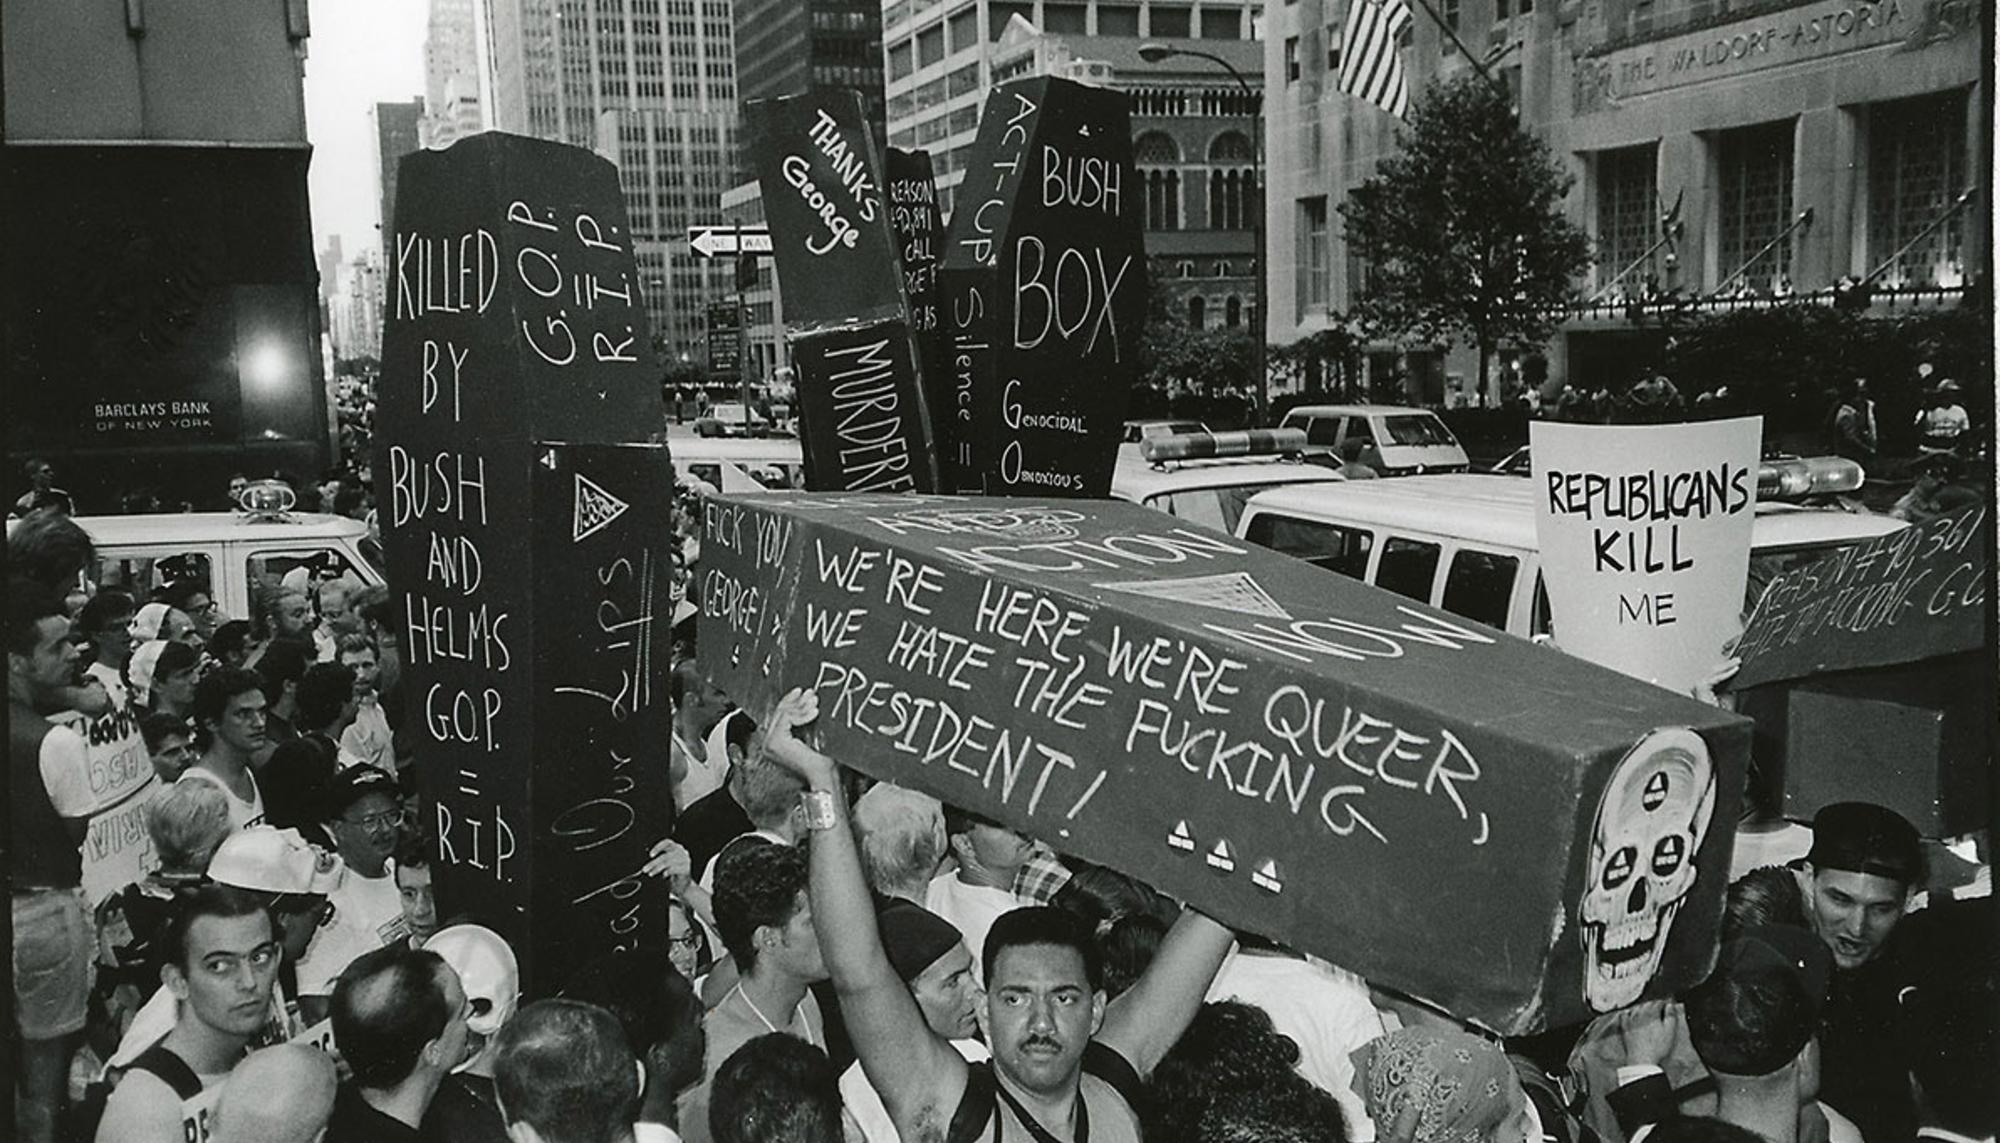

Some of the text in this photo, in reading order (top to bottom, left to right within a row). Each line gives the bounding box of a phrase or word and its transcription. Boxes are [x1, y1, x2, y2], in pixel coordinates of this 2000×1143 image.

[1620, 57, 1655, 83] THE
[808, 109, 880, 222] THANKS
[890, 179, 933, 204] REASON
[1043, 145, 1120, 216] BUSH
[397, 229, 498, 319] KILLED
[508, 202, 576, 365] G.O.P.
[1014, 236, 1132, 363] BOX
[423, 341, 469, 421] BY
[954, 287, 989, 422] Silence
[95, 402, 210, 417] BARCLAYS BANK
[96, 419, 211, 431] OF NEW YORK
[391, 446, 487, 527] BUSH
[1547, 462, 1748, 520] REPUBLICANS
[427, 532, 482, 595] AND
[936, 527, 1247, 571] ACTION
[1594, 524, 1693, 573] KILL
[406, 592, 510, 671] HELMS
[1203, 605, 1496, 661] NOW
[1618, 592, 1677, 627] ME
[426, 683, 501, 751] G.O.P.
[807, 603, 1388, 843] WE HATE THE FUCKING
[816, 538, 1489, 844] WE'RE HERE, WE'RE QUEER,
[459, 770, 480, 795] =
[814, 661, 1106, 837] PRESIDENT!
